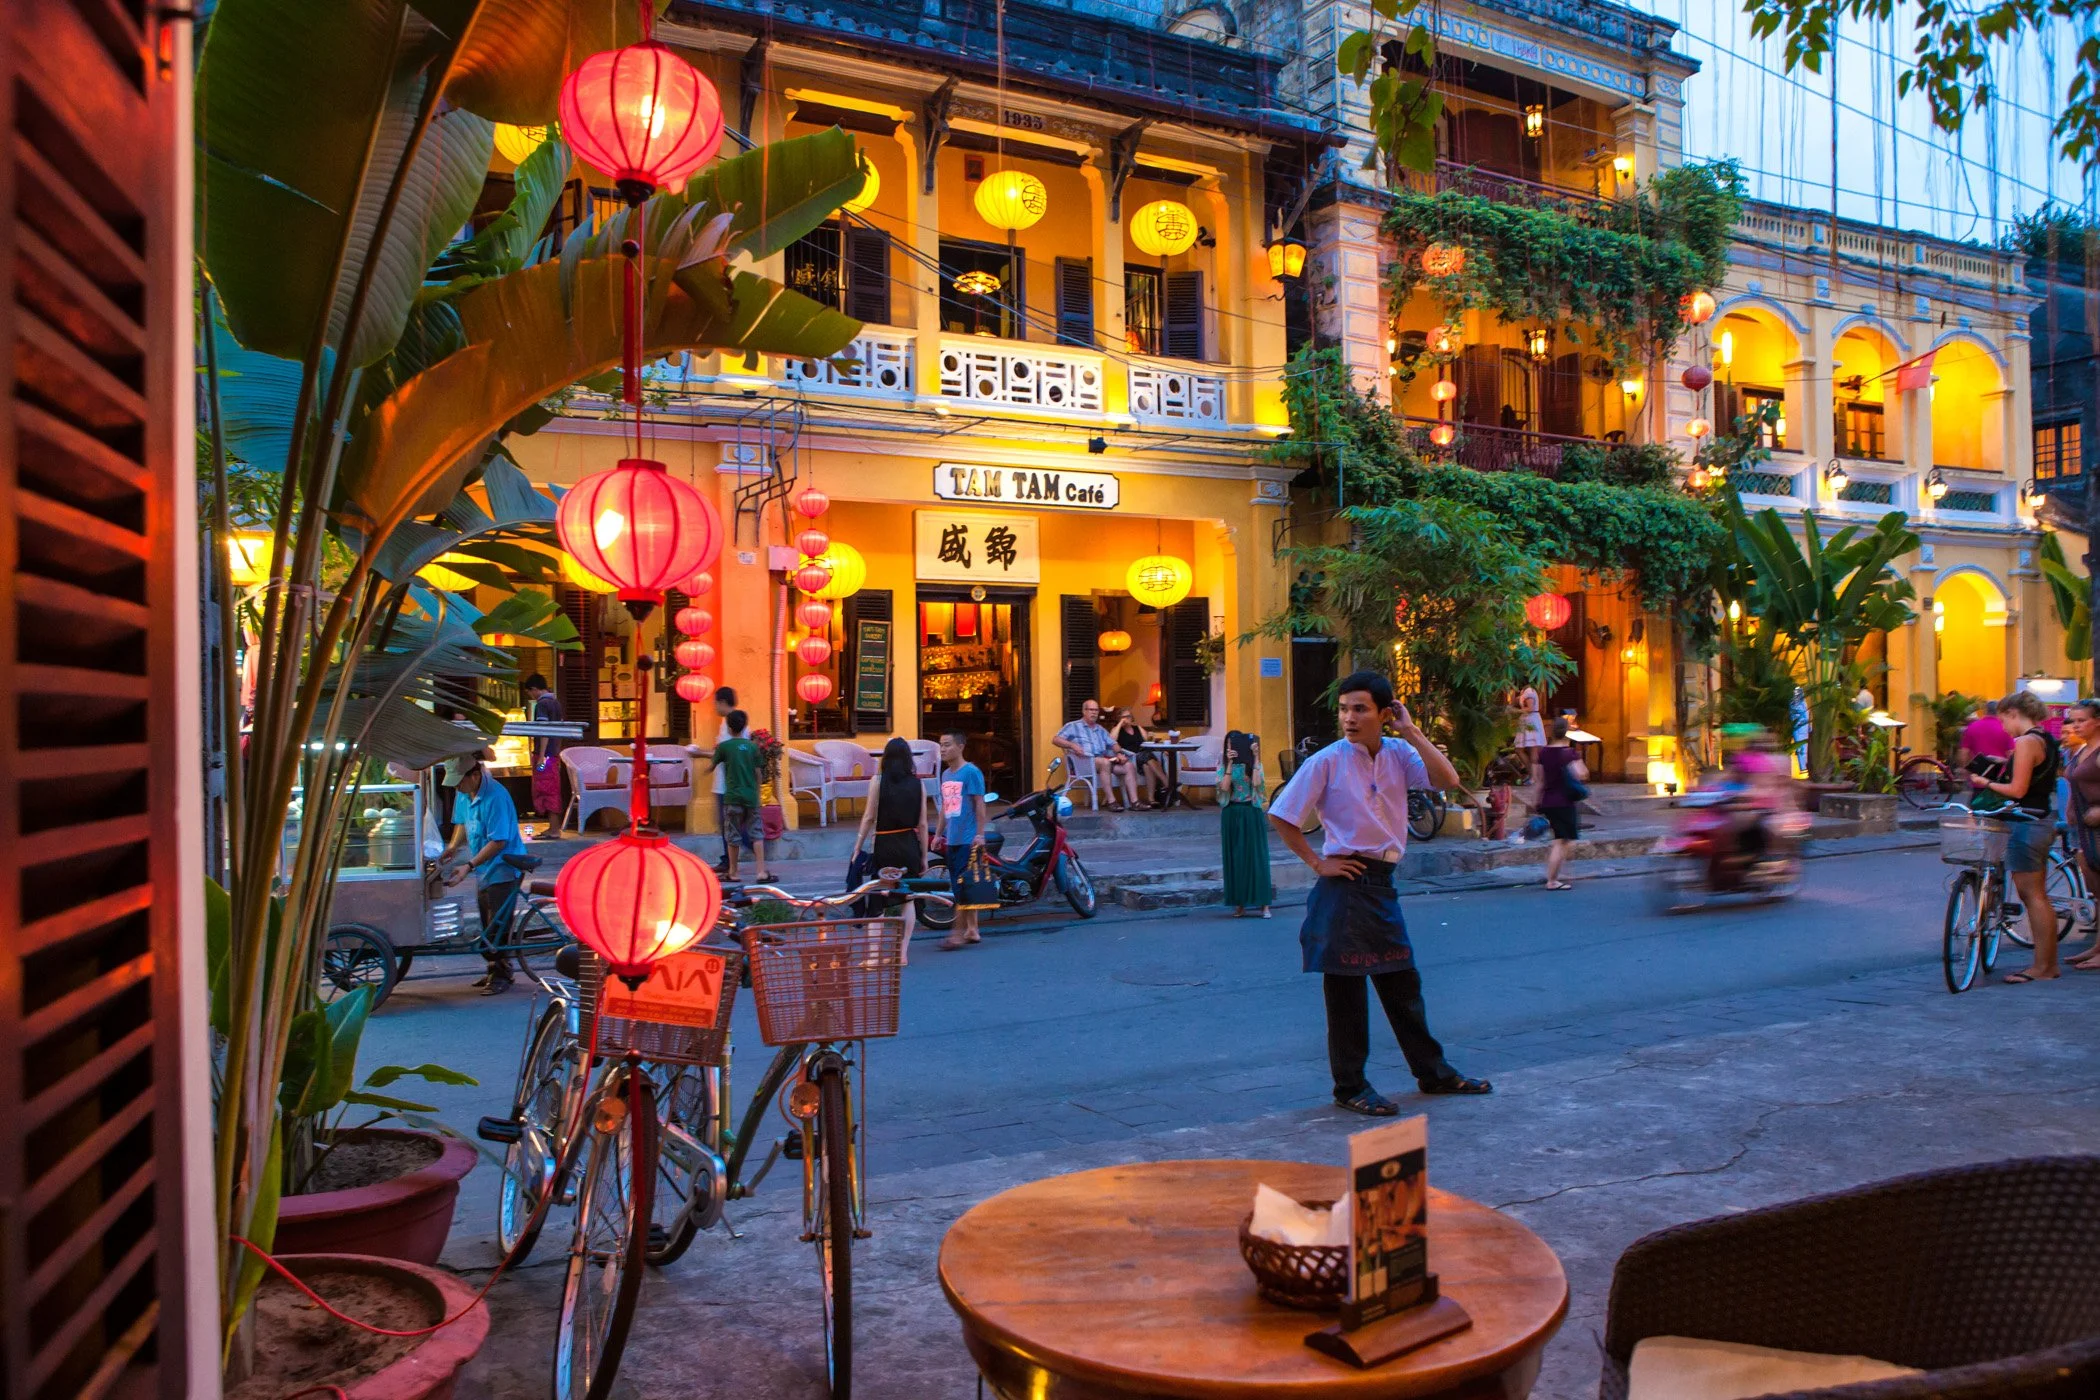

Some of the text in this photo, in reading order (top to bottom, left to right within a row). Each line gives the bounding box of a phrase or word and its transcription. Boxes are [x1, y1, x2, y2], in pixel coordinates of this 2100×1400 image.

[1004, 110, 1043, 130] 1935
[951, 467, 1104, 504] TAM TAM Café
